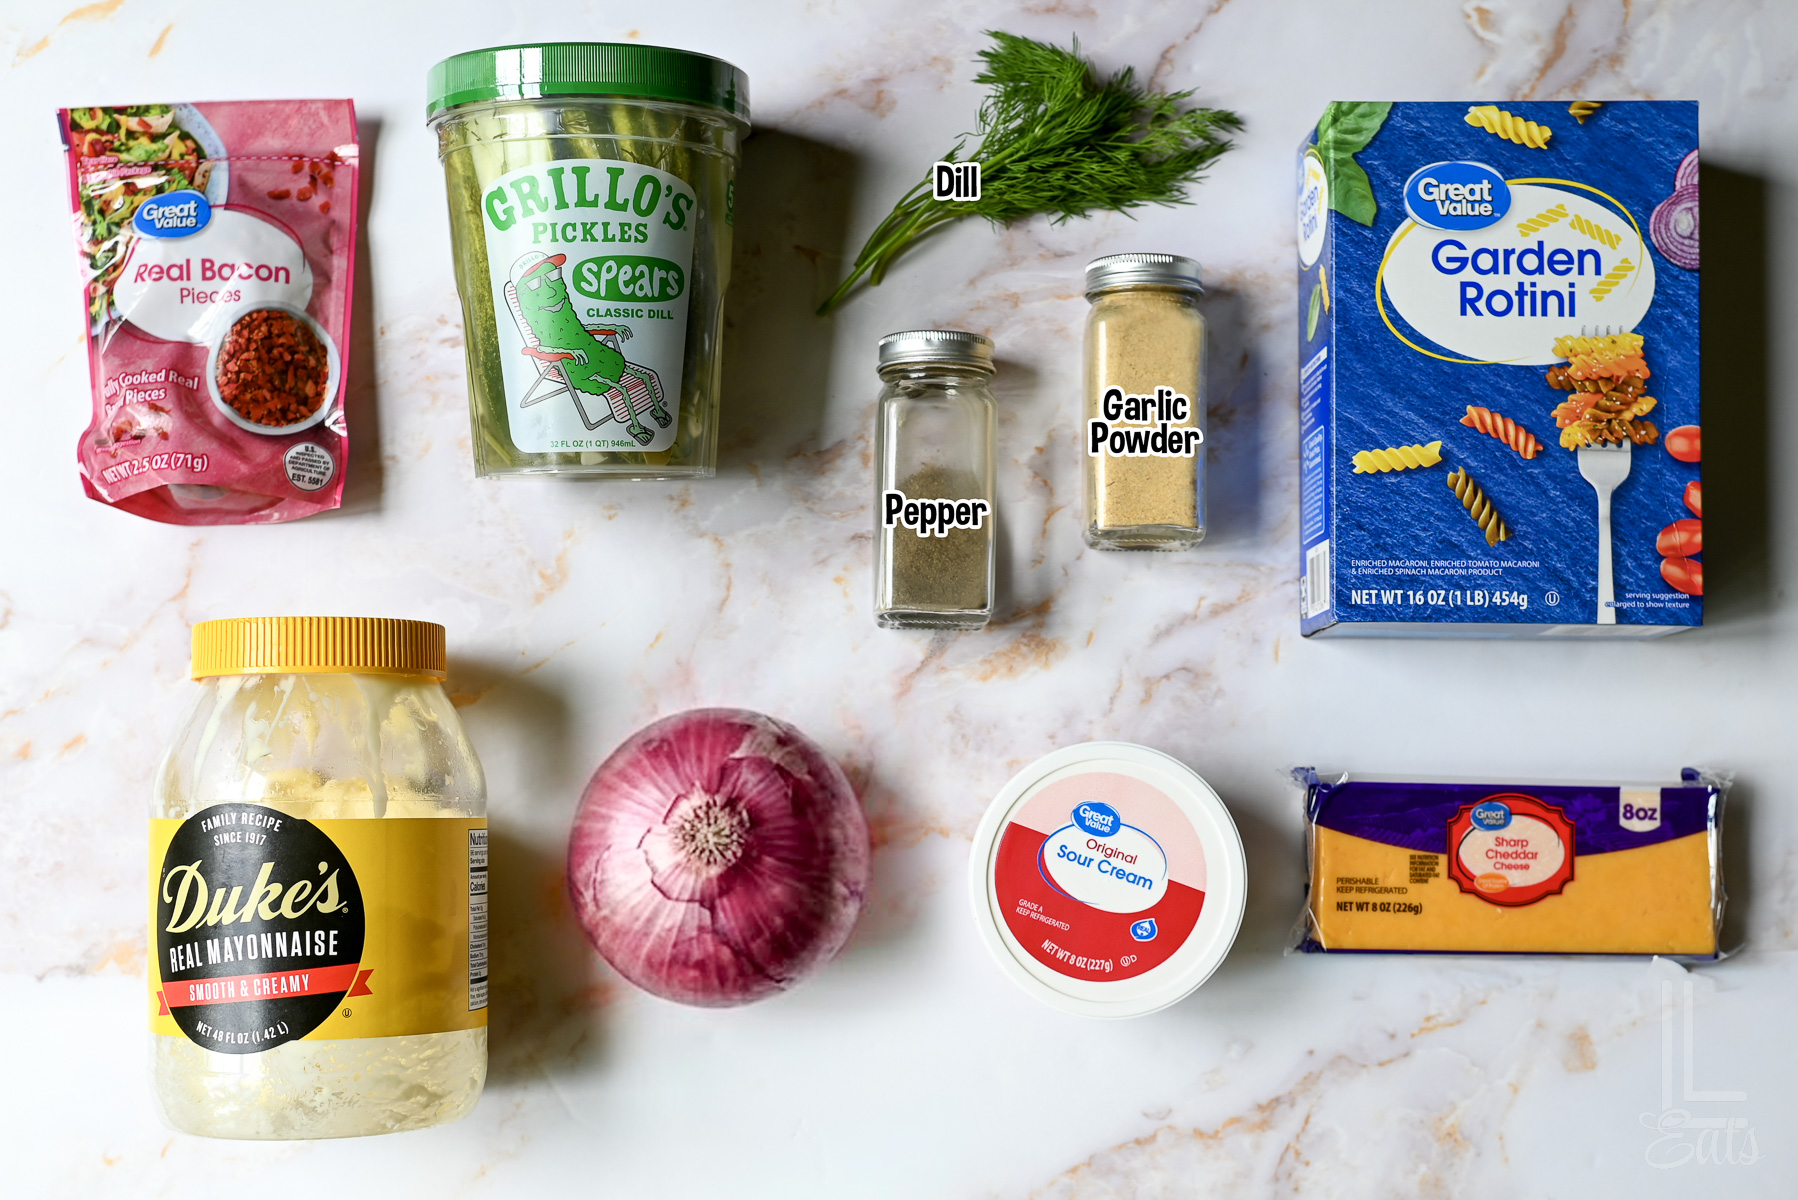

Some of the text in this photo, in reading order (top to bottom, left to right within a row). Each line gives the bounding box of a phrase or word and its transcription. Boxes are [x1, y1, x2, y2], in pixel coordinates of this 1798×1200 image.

[1418, 177, 1493, 202] Great
[485, 166, 693, 231] GRILLO'S
[142, 200, 198, 221] Great
[1435, 200, 1493, 216] Value
[154, 216, 197, 229] Value
[532, 222, 648, 244] PICKLES
[1432, 239, 1601, 276] Garden
[134, 258, 291, 285] Real Bacon
[180, 288, 241, 304] Pieces
[1460, 281, 1576, 317] Rotini
[587, 308, 673, 319] CLASSIC DILL
[104, 369, 199, 398] ully Cooked Real
[125, 388, 166, 405] Pieces
[304, 445, 317, 453] U.S.
[586, 440, 592, 448] (1
[595, 440, 609, 448] QT)
[132, 457, 150, 474] 2.5
[152, 454, 169, 469] OZ
[171, 453, 207, 472] (71g)
[292, 473, 306, 483] EST.
[1389, 560, 1429, 568] MACARONI,
[1468, 560, 1499, 568] TOMATO
[1352, 590, 1528, 609] NET WT 16 OZ (1 LB) 454g
[1626, 592, 1689, 600] serving suggestion
[1605, 601, 1635, 609] enlarged
[1080, 805, 1114, 826] Great
[1476, 809, 1504, 819] Great
[1623, 803, 1657, 821] 8oz
[201, 813, 282, 832] FAMILY RECIPE
[1085, 818, 1110, 833] Value
[214, 832, 267, 846] SINCE 1917
[1495, 837, 1529, 849] Sharp
[1086, 839, 1137, 865] Original
[1486, 849, 1539, 860] Cheddar
[1057, 845, 1153, 890] Sour Cream
[1494, 861, 1530, 870] Cheese
[1336, 877, 1379, 885] PERISHABLE
[163, 860, 347, 933] Duke's
[1355, 886, 1408, 894] REFRIGERATED
[1019, 899, 1039, 912] GRADE
[1336, 902, 1422, 915] NET WT 8 OZ (226g)
[1016, 906, 1070, 931] KEEP REFRIGERATED
[170, 930, 338, 973] REAL MAYONNAISE
[1041, 939, 1113, 973] NET WT 8 OZ (227g)
[190, 974, 309, 1001] SMOOTH & CREAMY
[196, 1021, 289, 1044] NET 48 FL OZ (1.42 L)
